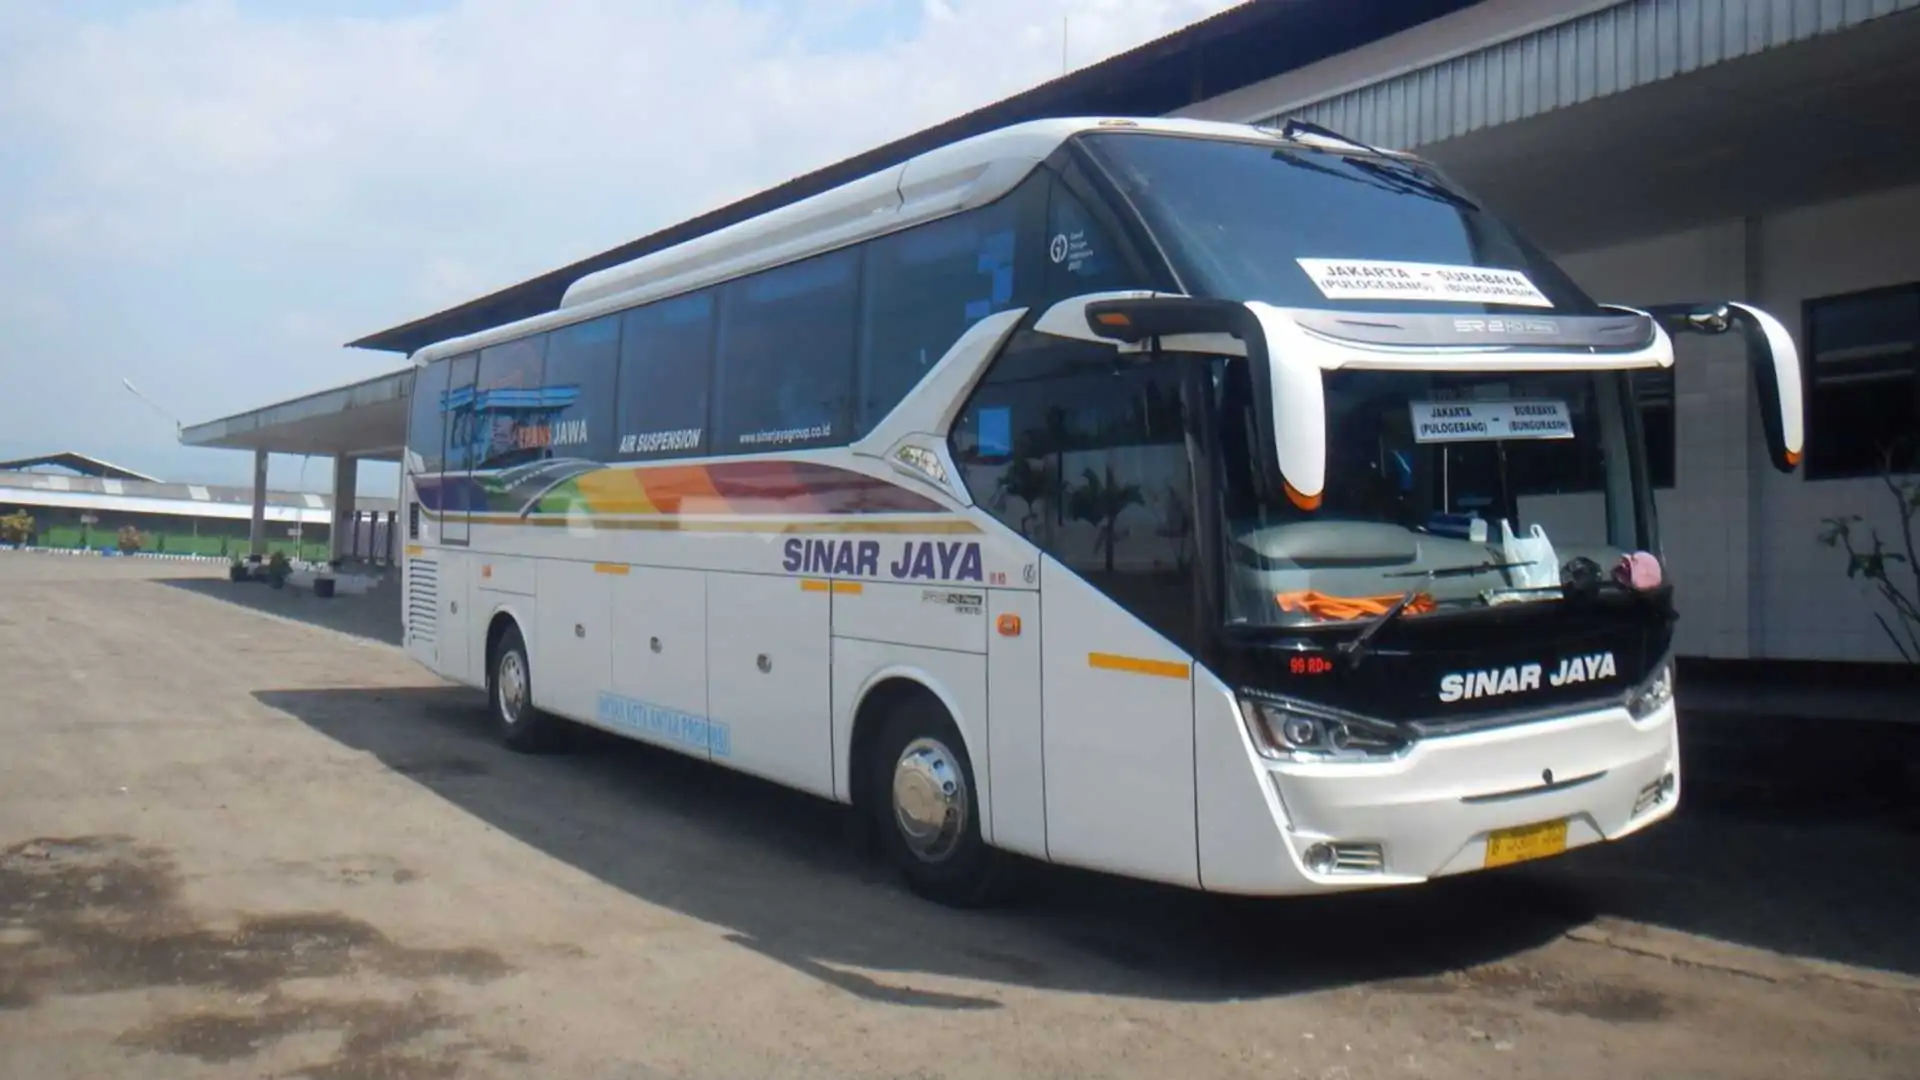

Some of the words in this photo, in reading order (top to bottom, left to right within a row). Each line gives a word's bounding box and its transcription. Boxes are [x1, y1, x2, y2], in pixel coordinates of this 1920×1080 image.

[1326, 265, 1411, 279] JAKARTA
[1436, 269, 1524, 288] SURABAYA
[1430, 407, 1473, 418] JAKARTA
[1514, 405, 1558, 416] SURABAYA
[553, 418, 587, 446] JAWA
[739, 421, 831, 444] www.sinarjayagroup.co.id
[1420, 421, 1488, 435] (PULOGEBANG)
[618, 434, 637, 453] AIR
[636, 427, 702, 452] SUSPENSION
[782, 538, 880, 576] SINAR
[890, 541, 983, 582] JAYA
[1290, 656, 1305, 674] 99
[1439, 662, 1542, 703] SINAR
[1549, 651, 1617, 686] JAYA
